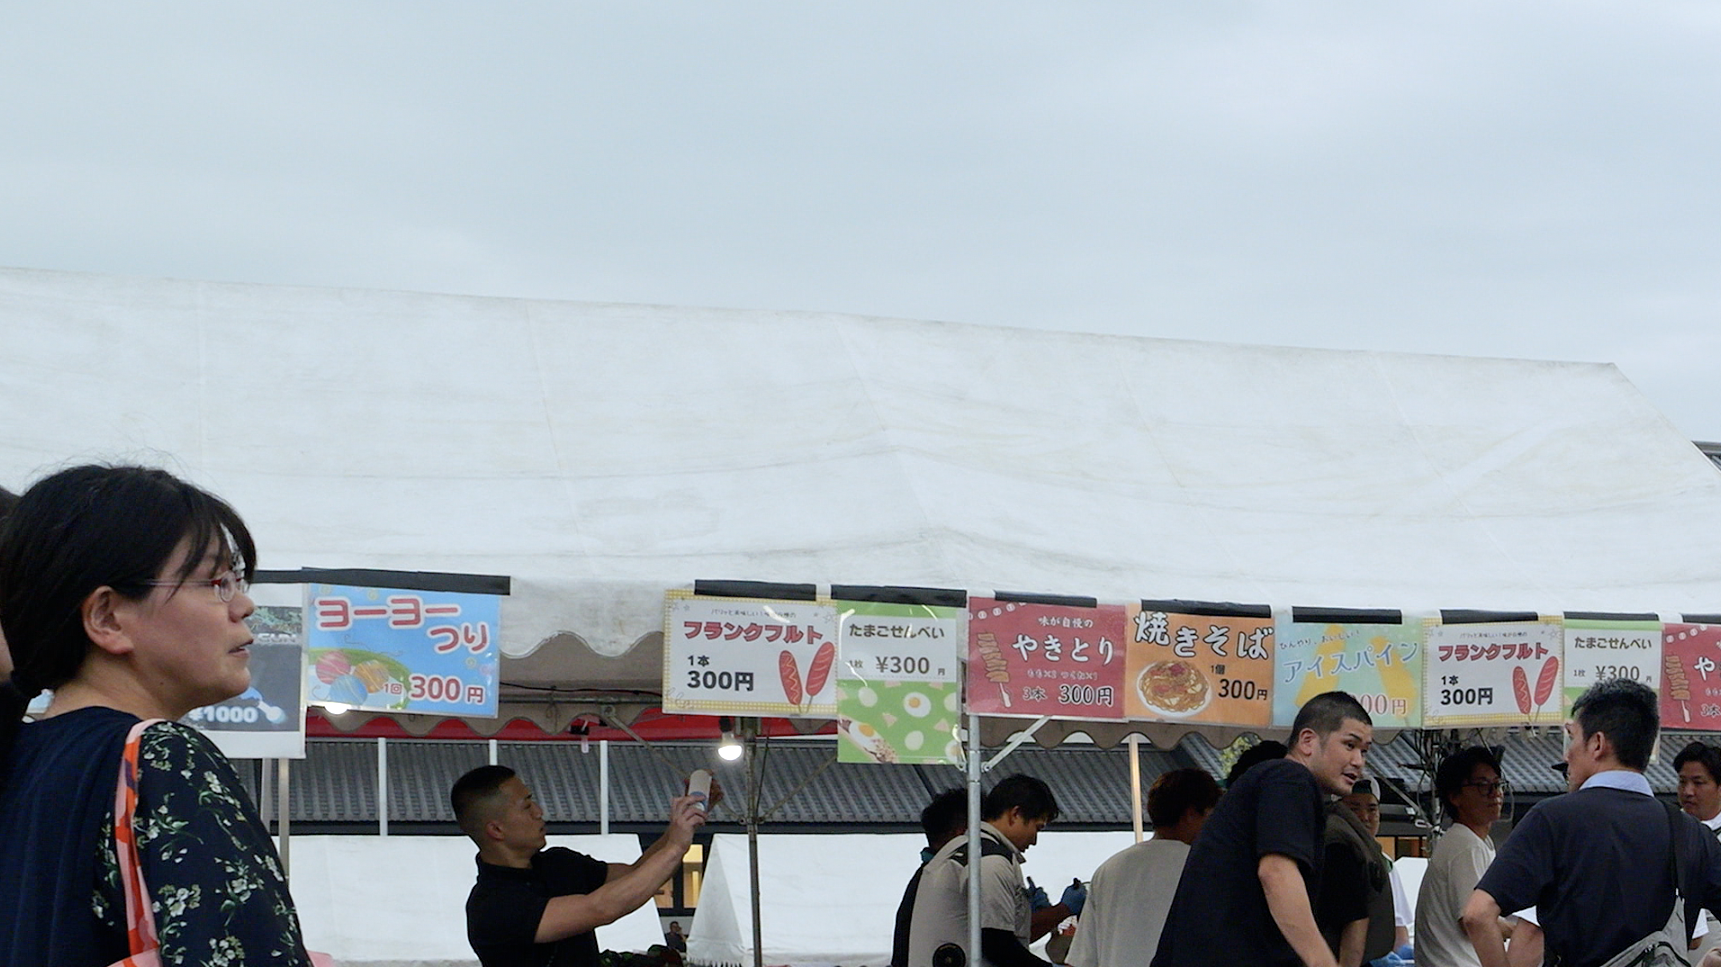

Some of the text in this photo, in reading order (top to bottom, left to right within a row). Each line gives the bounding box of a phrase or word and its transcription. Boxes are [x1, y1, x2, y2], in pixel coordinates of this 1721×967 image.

[316, 596, 460, 629] ヨーヨー
[1038, 616, 1094, 629] 味が自慢の
[428, 622, 491, 653] つり
[683, 621, 823, 645] フランクフルト
[849, 623, 945, 640] たまごせんべい
[1133, 611, 1274, 660] 焼きそば
[1012, 634, 1114, 666] やきとり
[1438, 641, 1549, 662] フランクフルト
[1574, 636, 1652, 650] たまごせんべい
[687, 655, 710, 667] 1本
[875, 656, 930, 675] ¥300
[1283, 642, 1418, 683] アイスパイン
[687, 670, 755, 691] 300円
[1441, 675, 1459, 686] 1本
[1595, 665, 1640, 681] ¥300
[408, 675, 484, 704] 300円
[1022, 683, 1114, 707] 3本 300円
[1218, 678, 1268, 701] 300円
[1440, 687, 1493, 706] 300円
[1352, 693, 1407, 715] 00円
